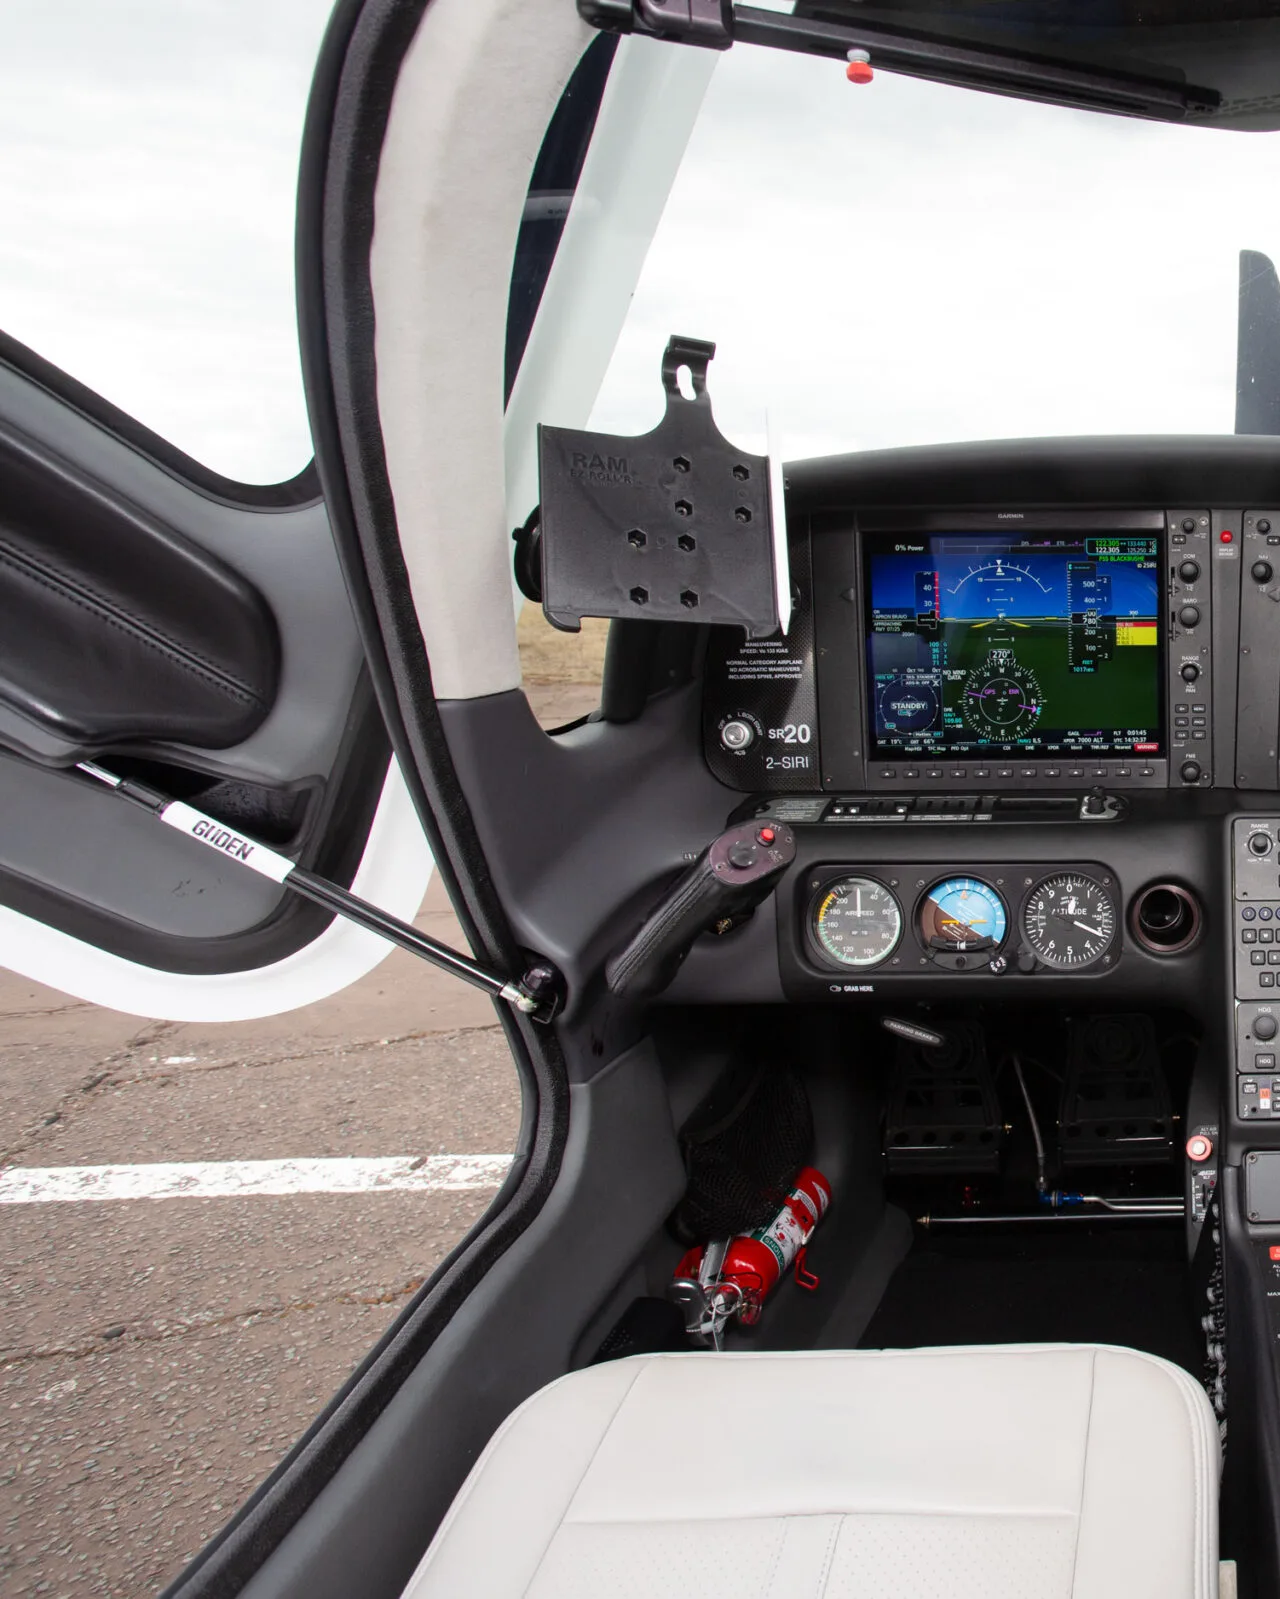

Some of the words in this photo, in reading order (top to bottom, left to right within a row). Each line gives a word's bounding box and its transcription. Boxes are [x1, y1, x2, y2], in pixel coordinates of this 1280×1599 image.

[572, 452, 628, 473] RAM
[895, 544, 907, 552] 0%
[891, 702, 926, 710] STANDBY
[768, 723, 811, 744] SR20
[765, 756, 809, 769] 2-SIRI
[769, 822, 782, 832] PTT
[1066, 883, 1072, 893] 0
[1048, 890, 1055, 899] 9
[836, 897, 848, 905] 200
[1038, 901, 1044, 910] 8
[1096, 902, 1103, 912] 2
[1037, 928, 1044, 938] 7
[1048, 940, 1056, 949] 6
[1084, 940, 1091, 948] 4
[1066, 945, 1073, 955] 5
